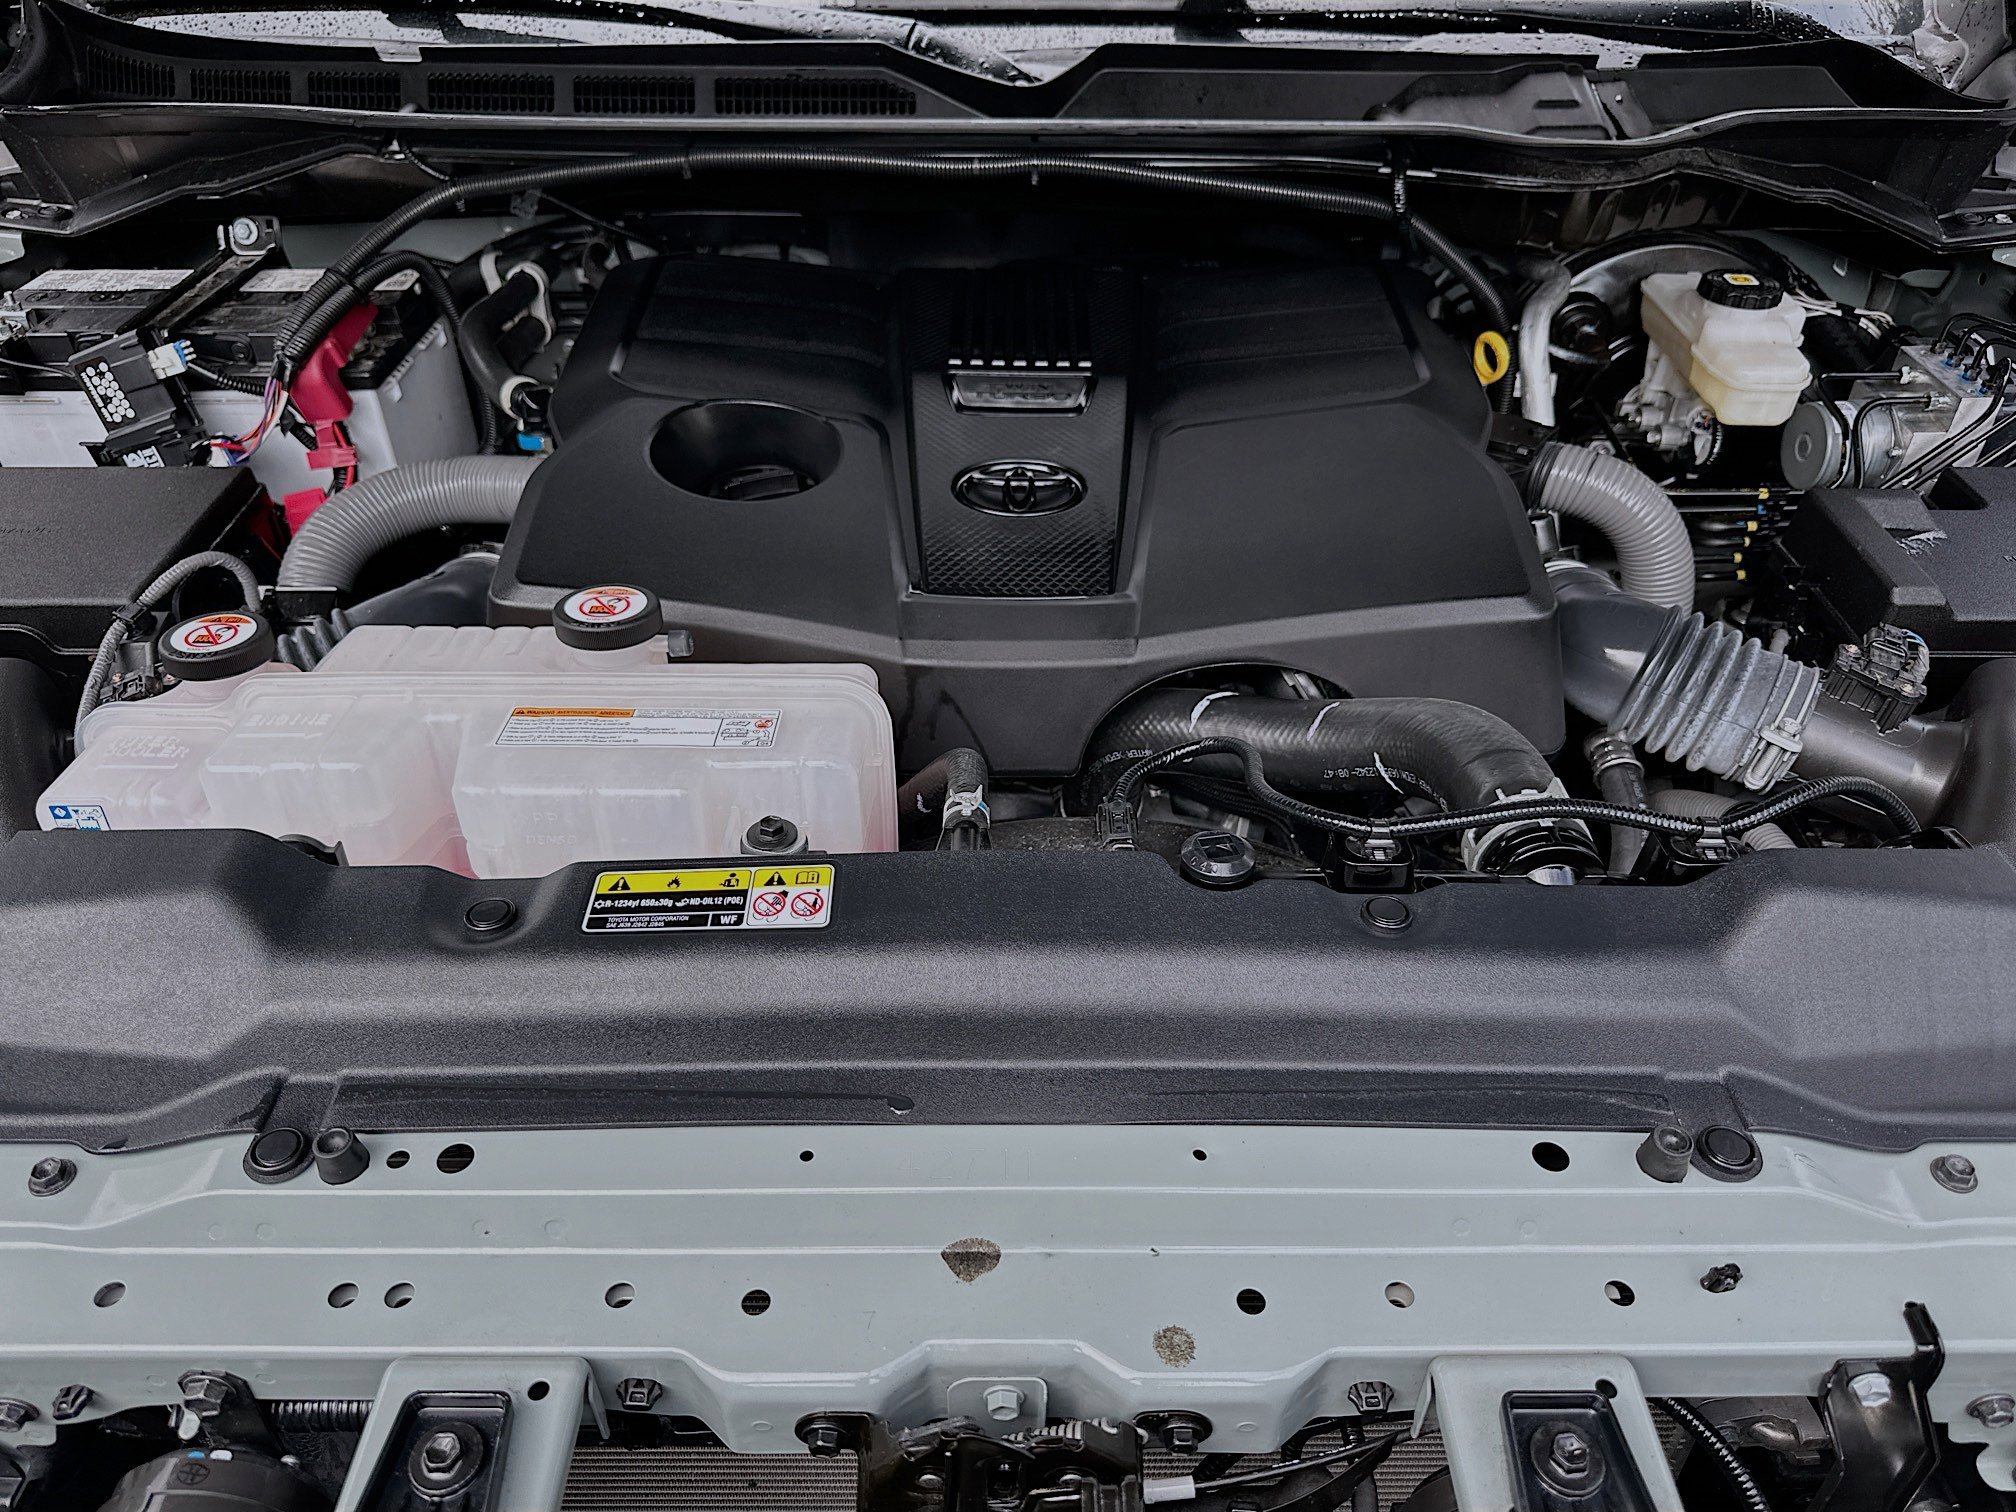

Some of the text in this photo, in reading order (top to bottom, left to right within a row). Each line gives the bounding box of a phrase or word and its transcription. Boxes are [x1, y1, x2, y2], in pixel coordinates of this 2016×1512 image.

[604, 898, 641, 908] R-1234yf
[723, 895, 744, 906] (POE)
[719, 914, 739, 925] WF
